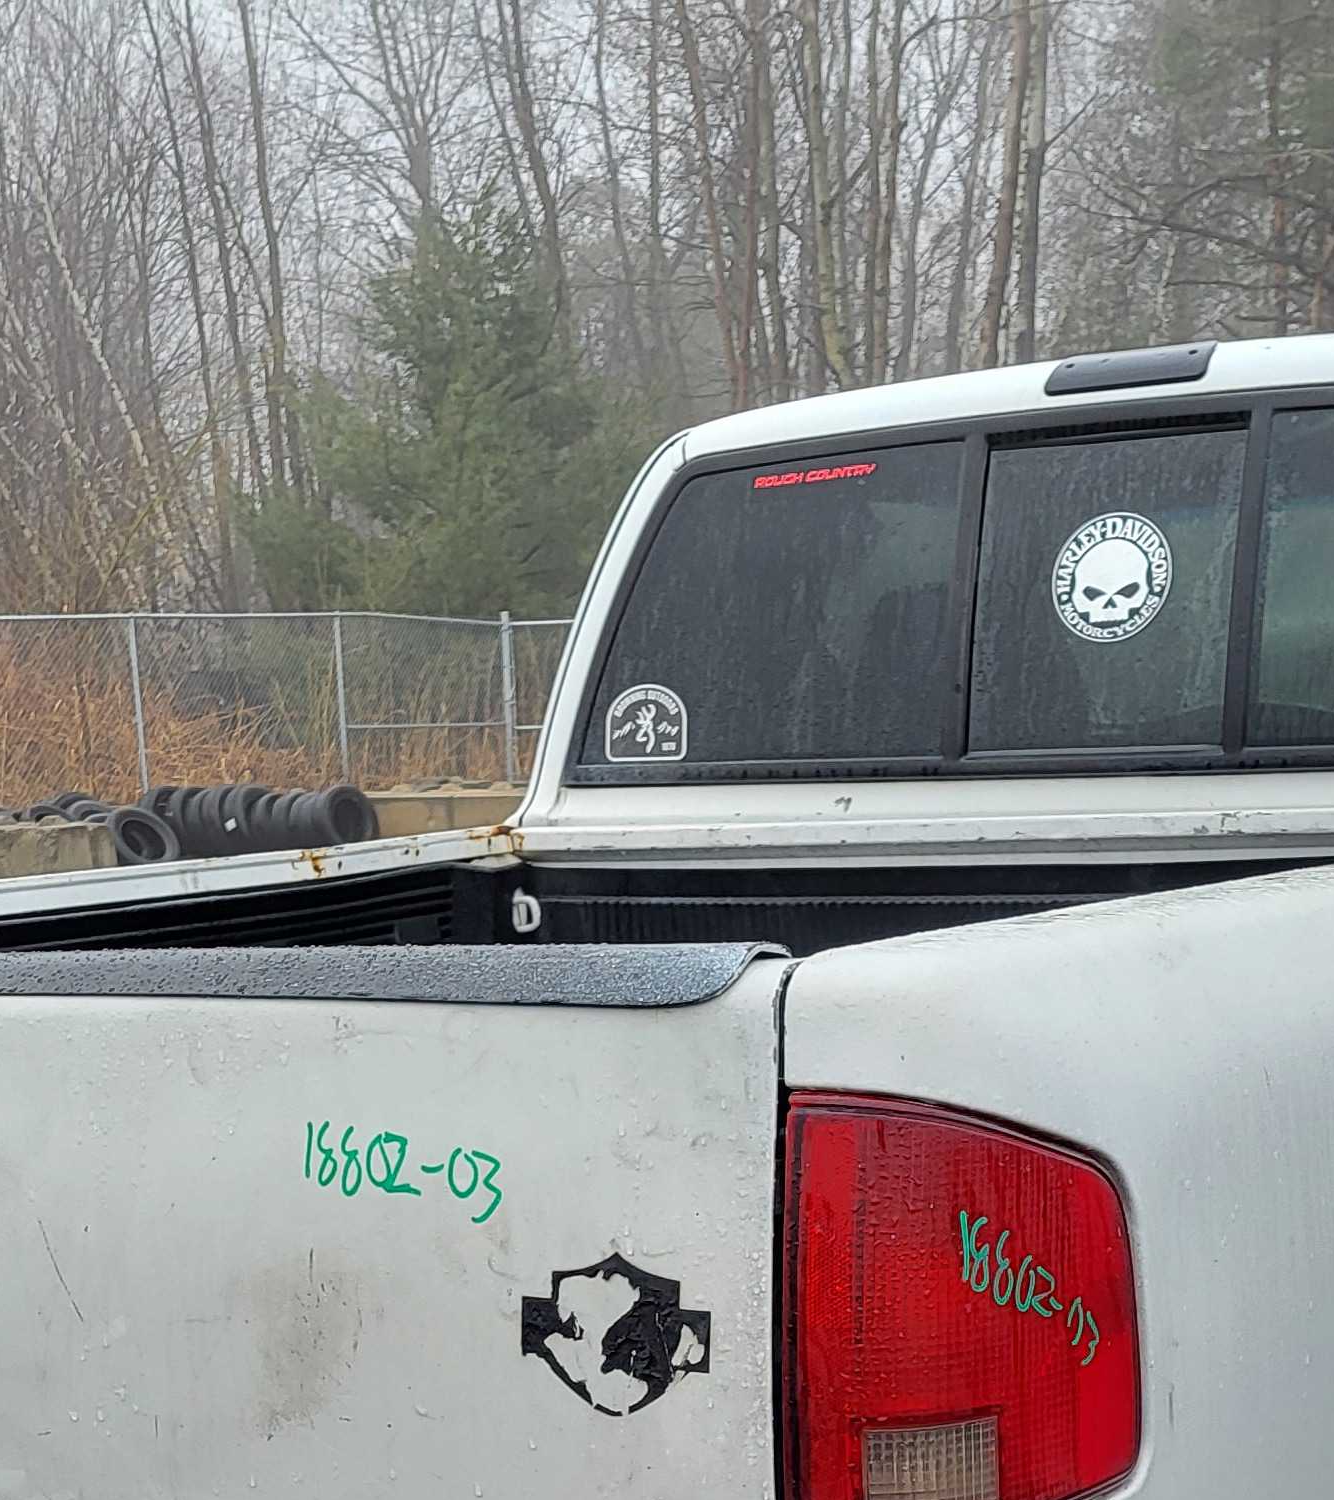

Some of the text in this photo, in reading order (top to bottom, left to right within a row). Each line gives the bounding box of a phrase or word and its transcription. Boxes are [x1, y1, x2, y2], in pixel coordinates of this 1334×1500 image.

[805, 463, 877, 483] COUNTRY
[1060, 594, 1160, 638] MOTORCYCLES
[304, 1120, 503, 1224] 18802-03
